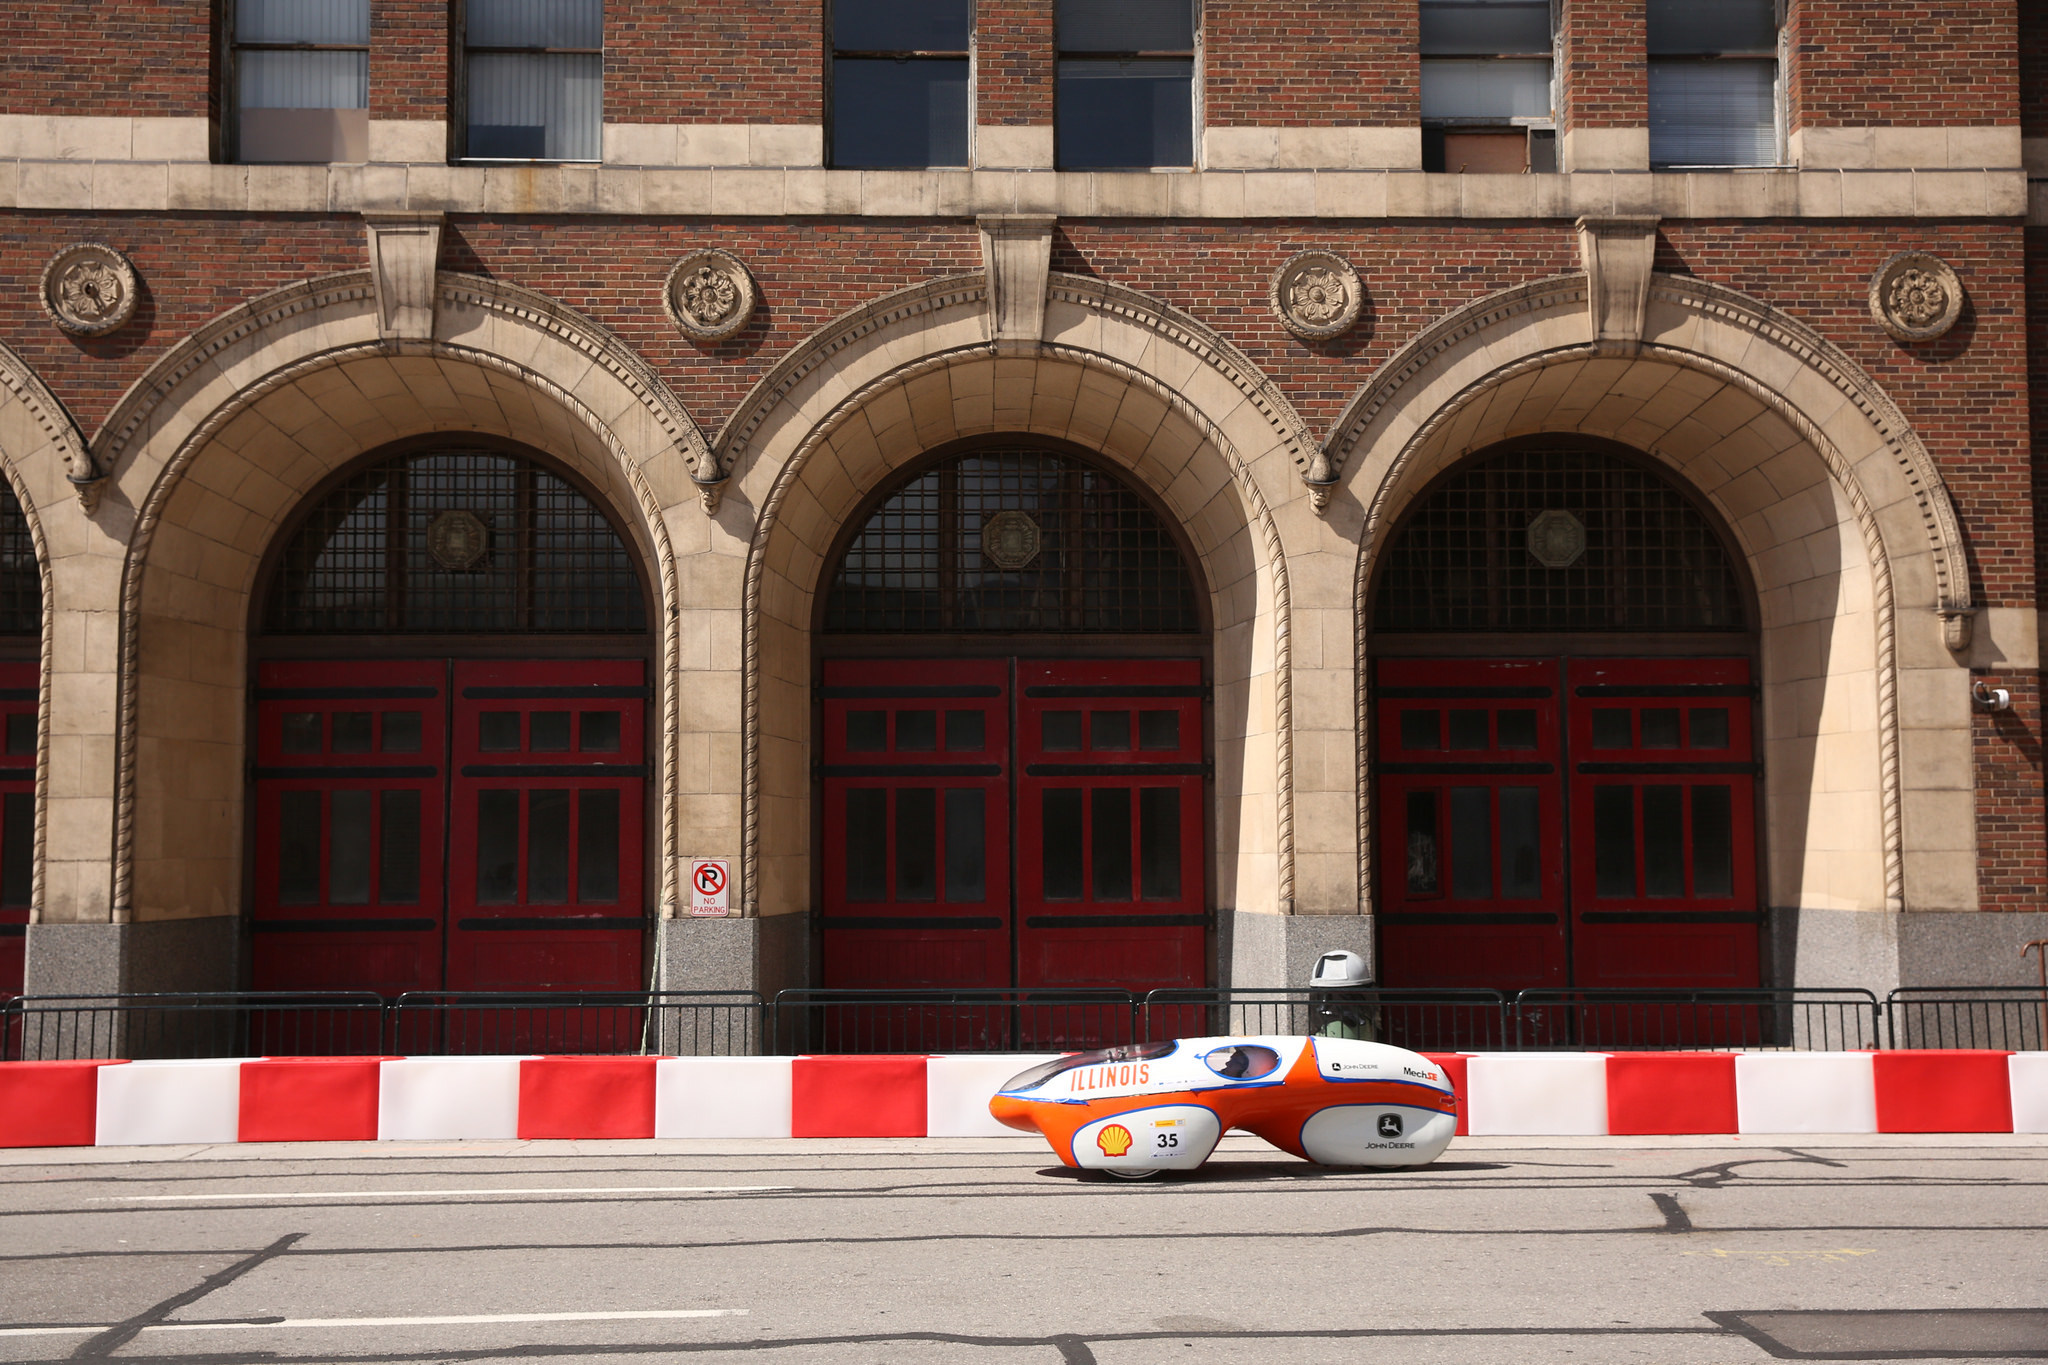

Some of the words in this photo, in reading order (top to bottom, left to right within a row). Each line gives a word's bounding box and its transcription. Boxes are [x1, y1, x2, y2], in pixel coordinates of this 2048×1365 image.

[703, 897, 716, 905] NO
[693, 906, 725, 914] PARKING
[1070, 1063, 1150, 1092] ILLINOIS
[1403, 1066, 1438, 1082] MechSE
[1157, 1133, 1179, 1148] 35
[1388, 1141, 1416, 1149] DEERE
